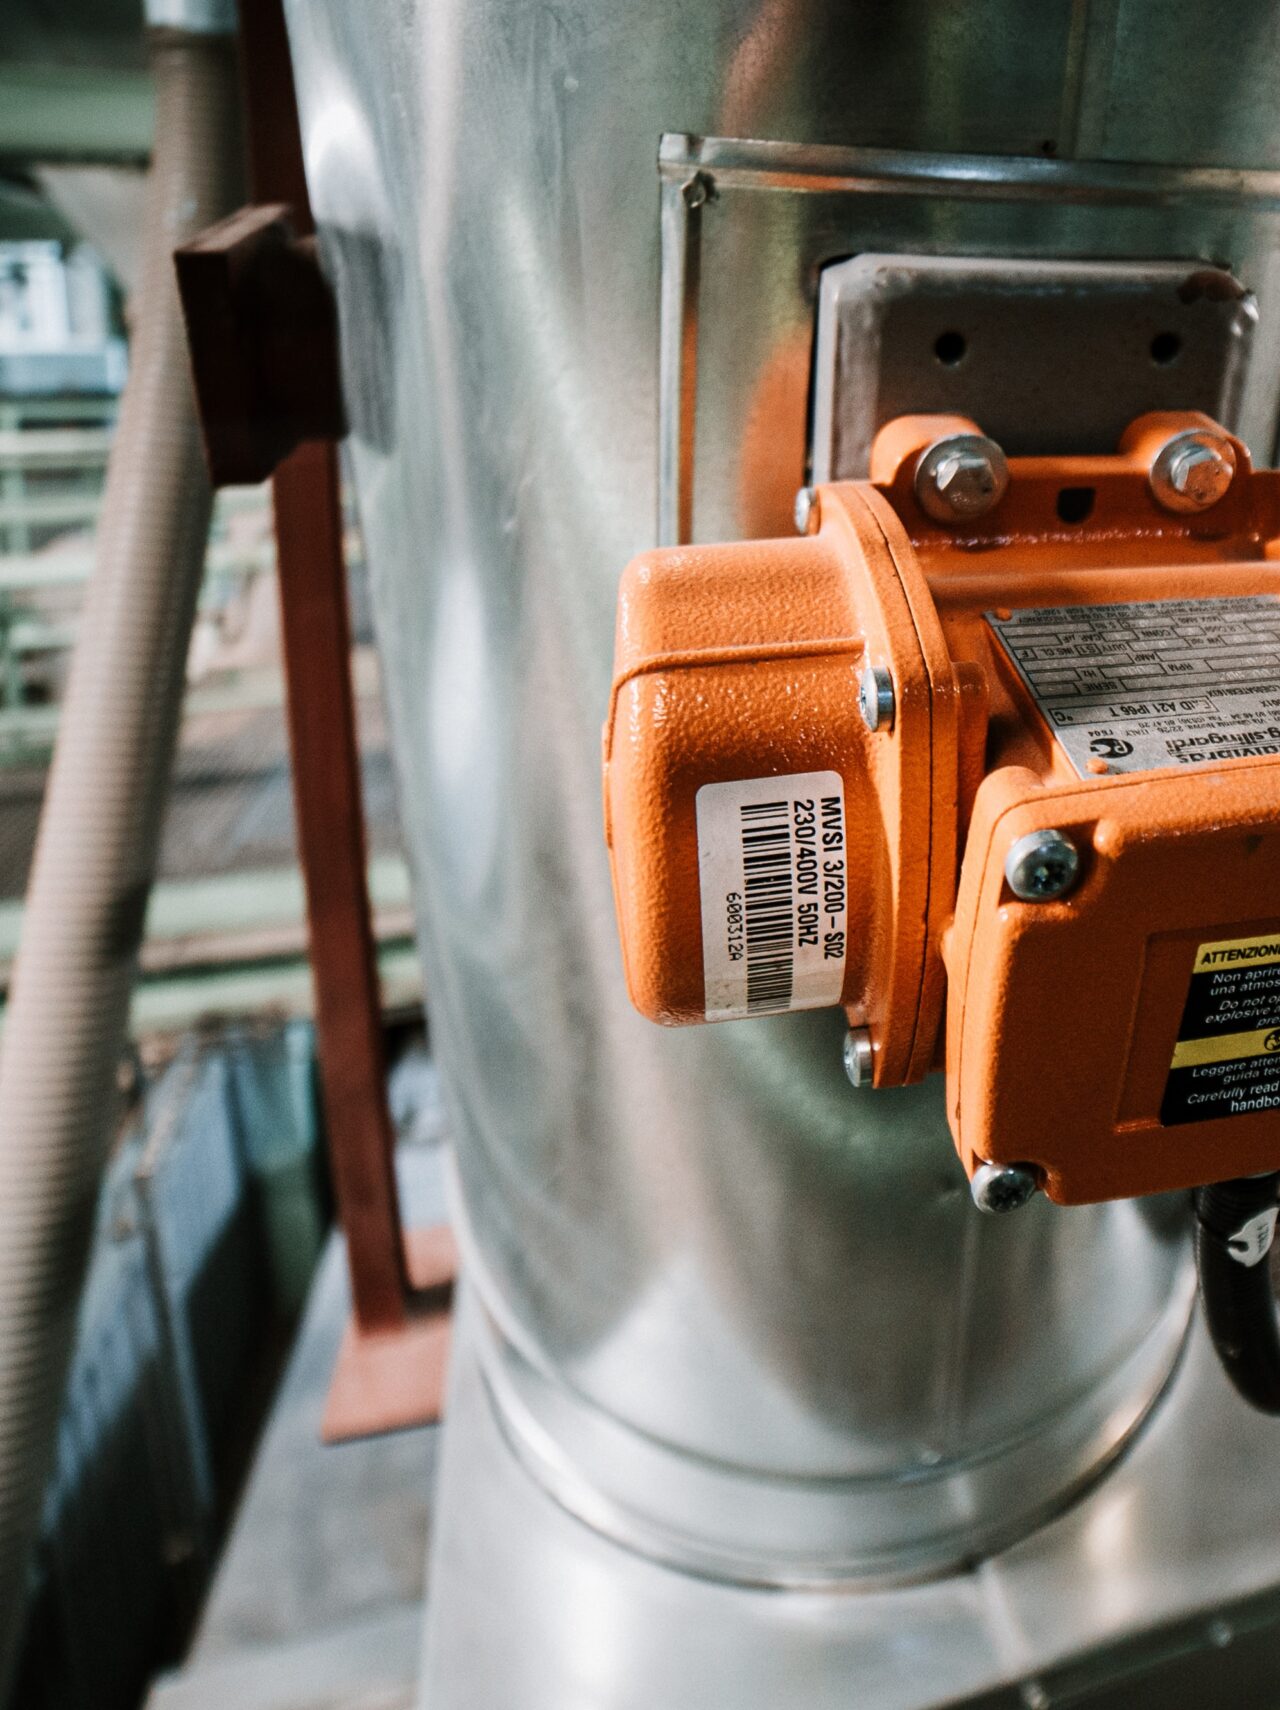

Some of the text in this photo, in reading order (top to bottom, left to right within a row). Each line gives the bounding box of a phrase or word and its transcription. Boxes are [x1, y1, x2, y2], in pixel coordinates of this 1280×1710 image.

[1080, 646, 1096, 654] S1
[1101, 644, 1126, 652] DUTY
[1083, 682, 1117, 691] SERIE
[1120, 705, 1150, 715] IP66
[1152, 703, 1176, 713] A21
[821, 797, 844, 852] MVSI
[794, 800, 819, 947] 230/400V 50HZ
[726, 893, 743, 961] 600312A
[1213, 973, 1241, 984] Non
[1210, 985, 1235, 996] una
[1220, 1000, 1238, 1011] Do
[1242, 997, 1266, 1007] not
[1205, 1007, 1270, 1024] explosive
[1192, 1062, 1246, 1078] Leggere
[1223, 1071, 1259, 1085] guida
[1188, 1087, 1246, 1104] Carefully
[1250, 1081, 1279, 1095] read
